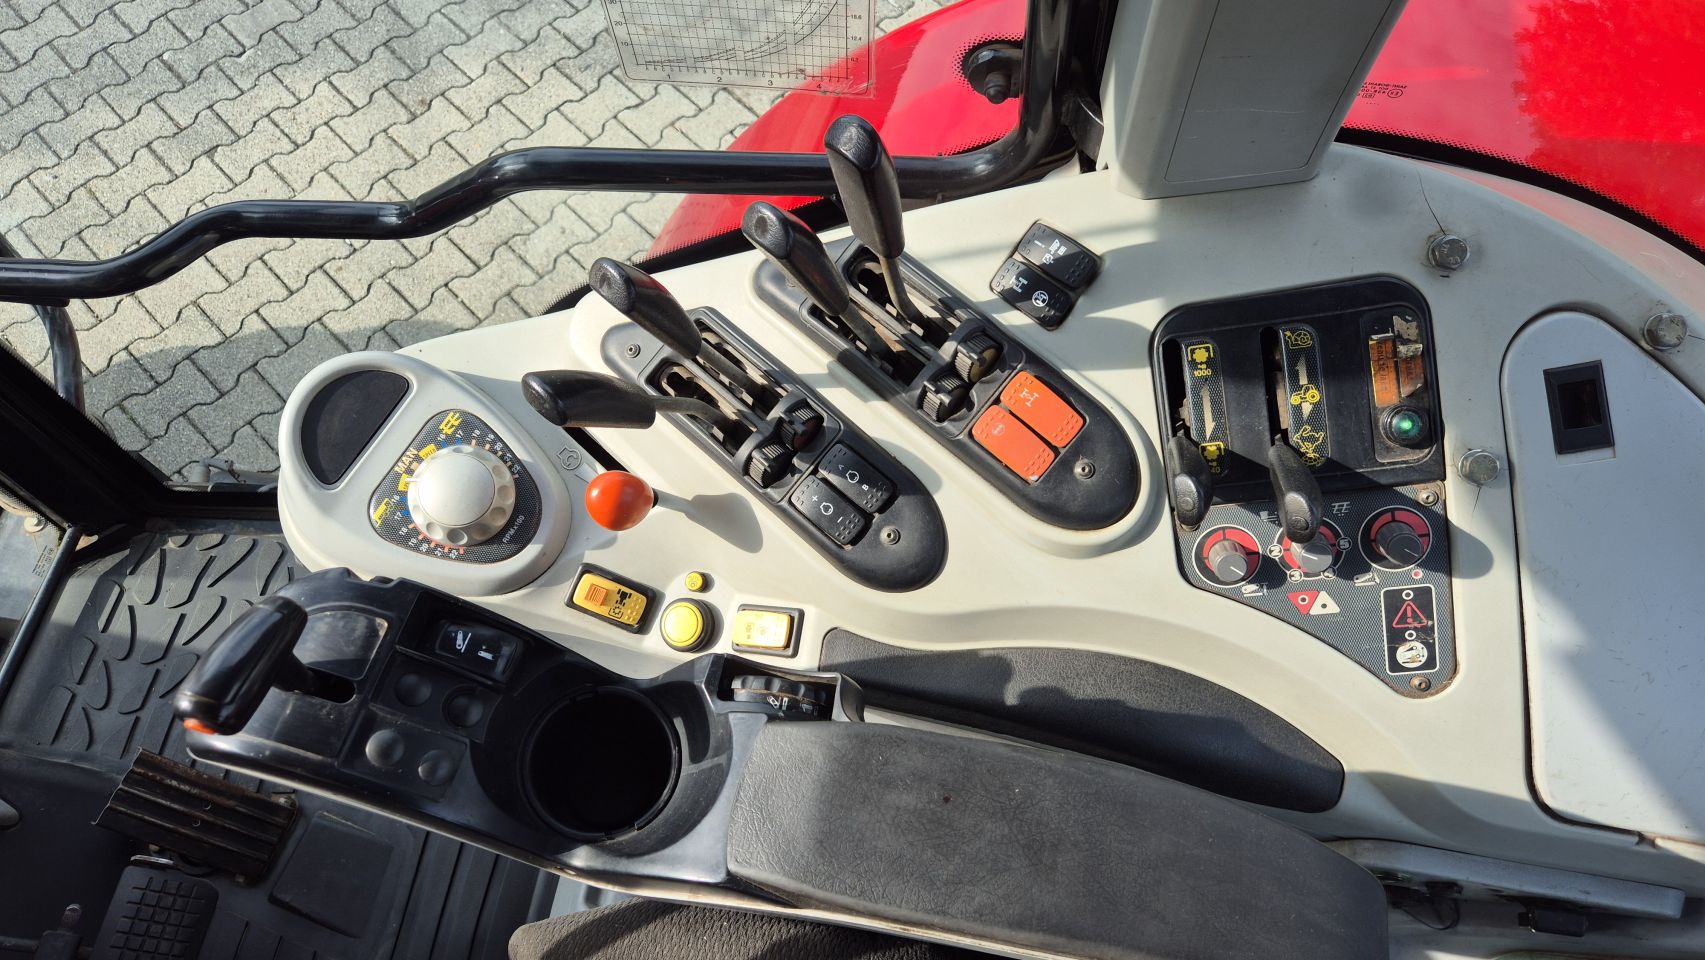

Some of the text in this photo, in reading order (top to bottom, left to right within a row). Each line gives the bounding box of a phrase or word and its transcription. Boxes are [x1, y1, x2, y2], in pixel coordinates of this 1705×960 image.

[1194, 368, 1212, 377] 1000
[394, 447, 419, 474] MAN
[394, 511, 402, 520] 17
[399, 527, 408, 536] 18
[1340, 539, 1350, 549] 5
[1270, 545, 1281, 557] 2
[1290, 570, 1300, 580] 3
